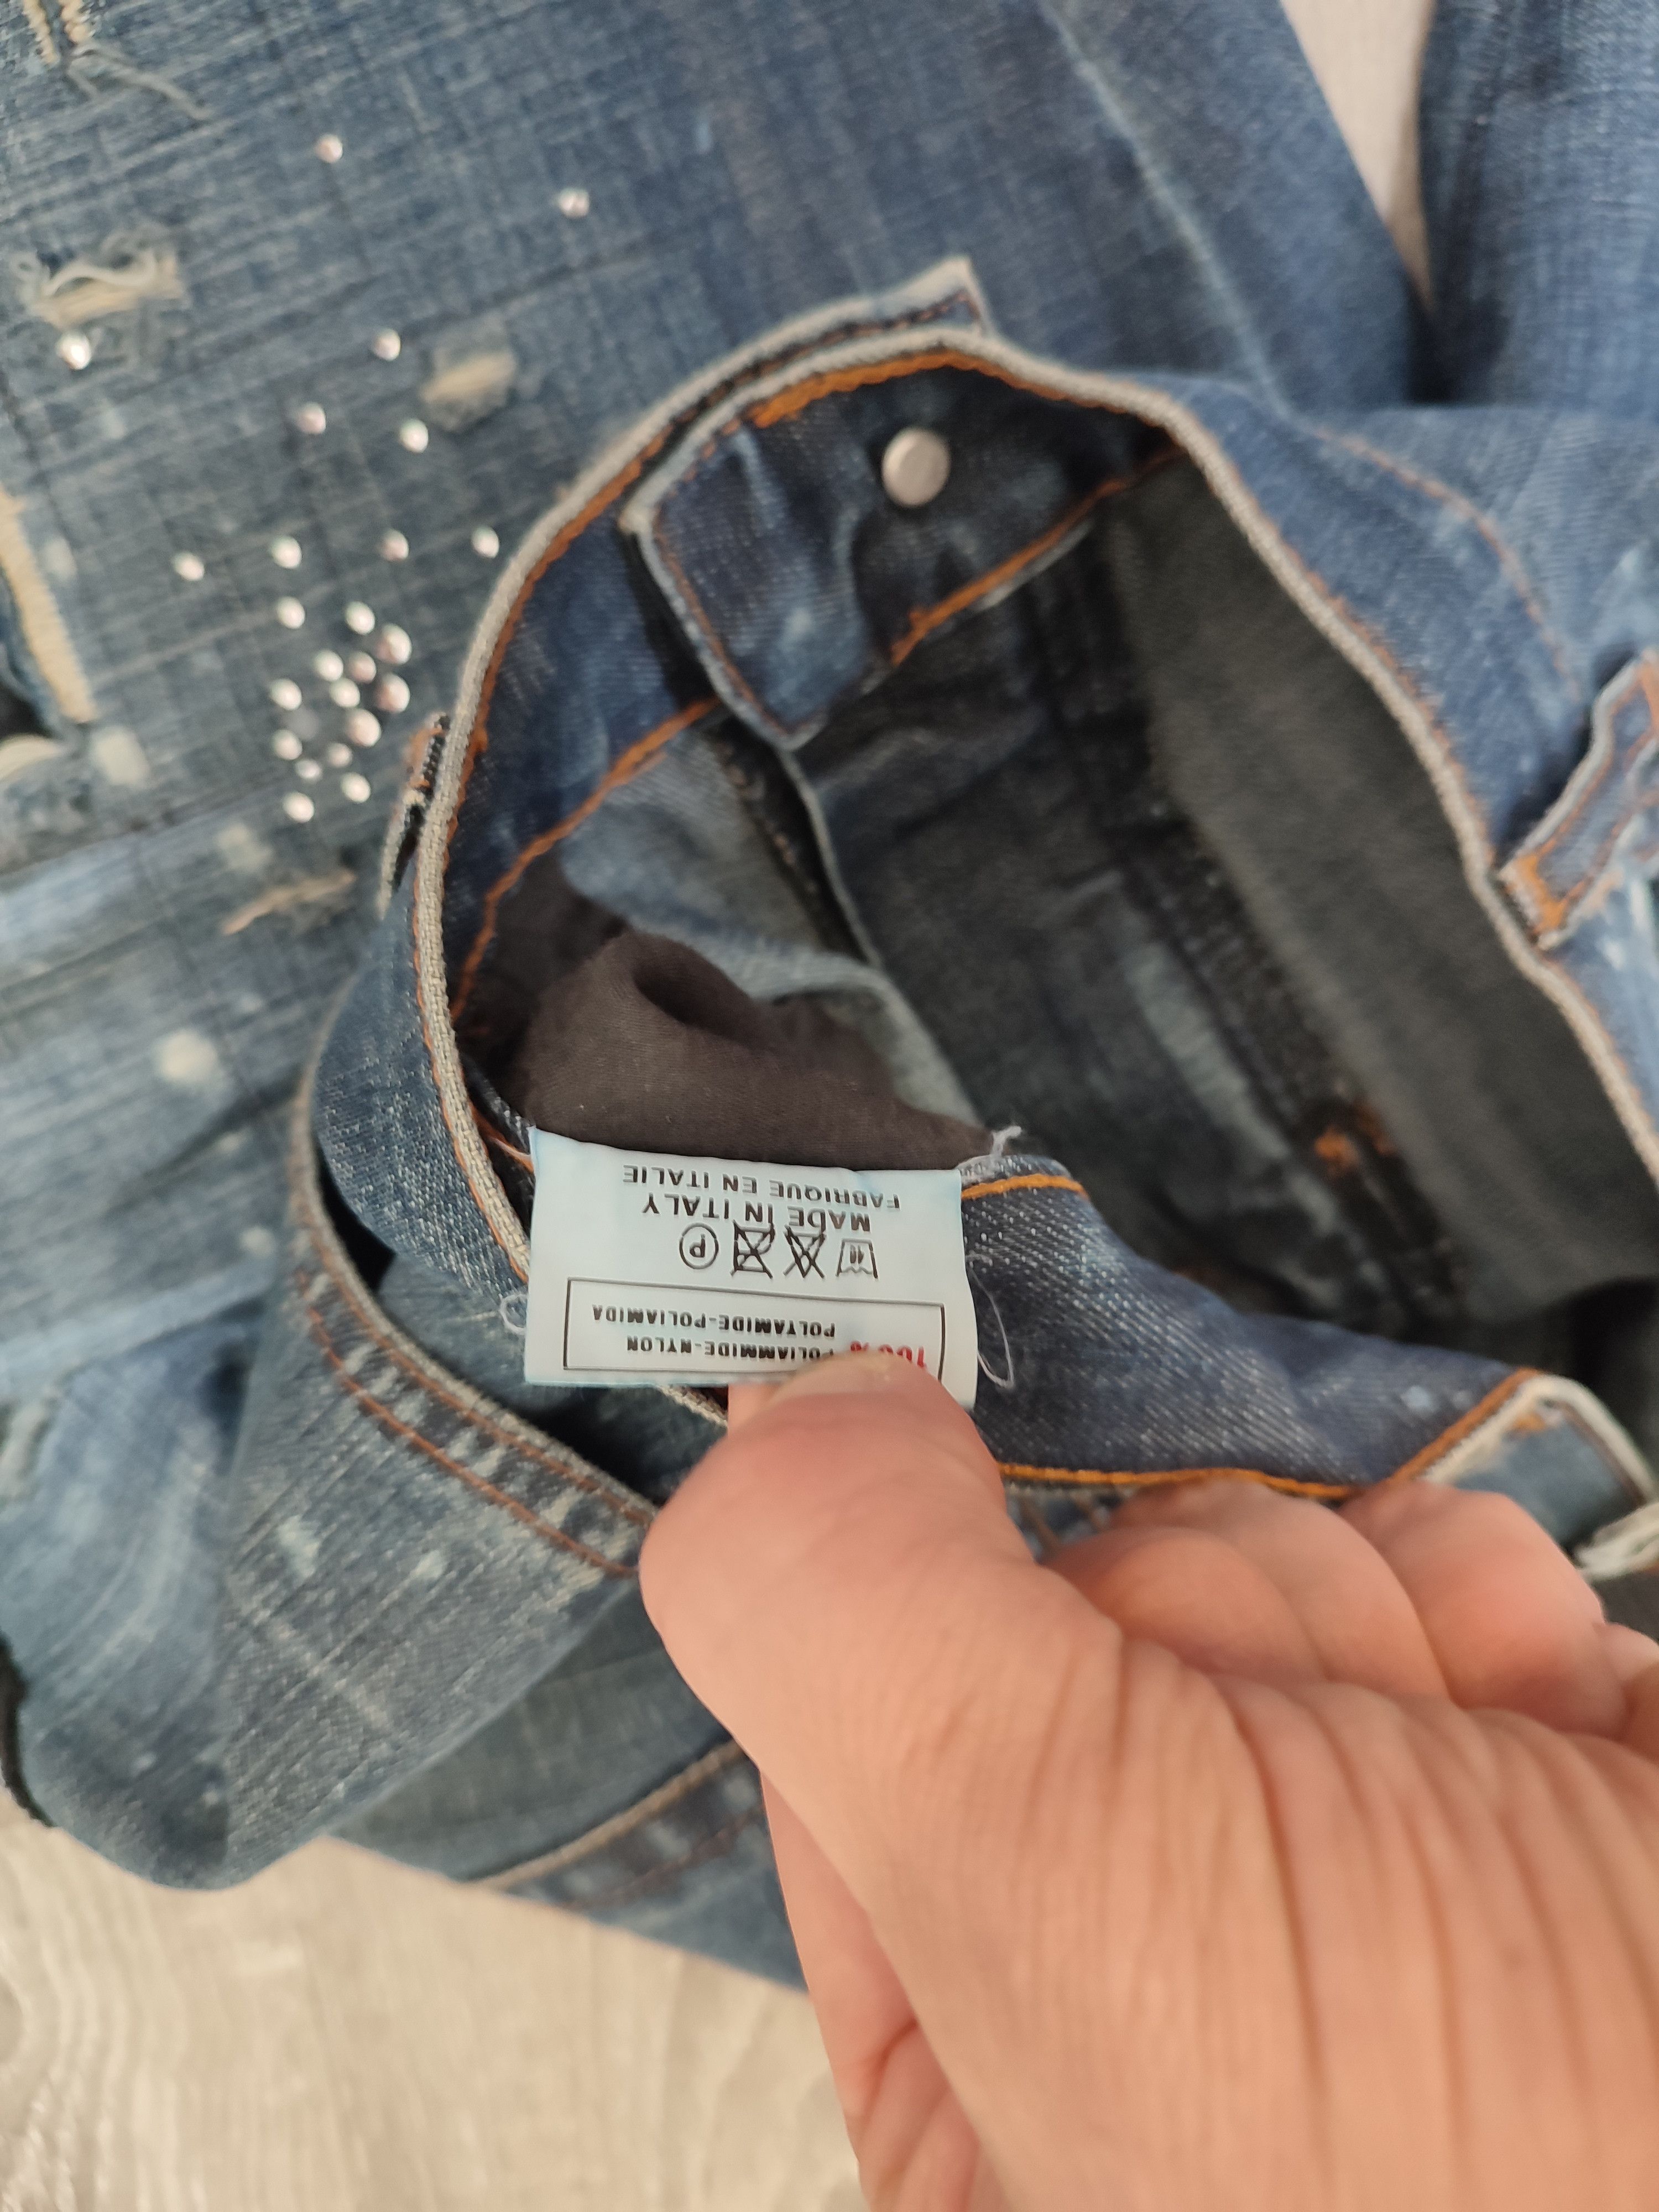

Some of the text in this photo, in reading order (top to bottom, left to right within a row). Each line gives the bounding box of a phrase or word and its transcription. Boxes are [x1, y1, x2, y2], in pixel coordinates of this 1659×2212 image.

[623, 1165, 900, 1209] FABRIQUE EN ITALIE
[643, 1192, 870, 1232] MADE IN ITALY
[690, 1234, 706, 1258] P
[592, 1305, 835, 1338] POLYAMIDE-POLIAMIDA
